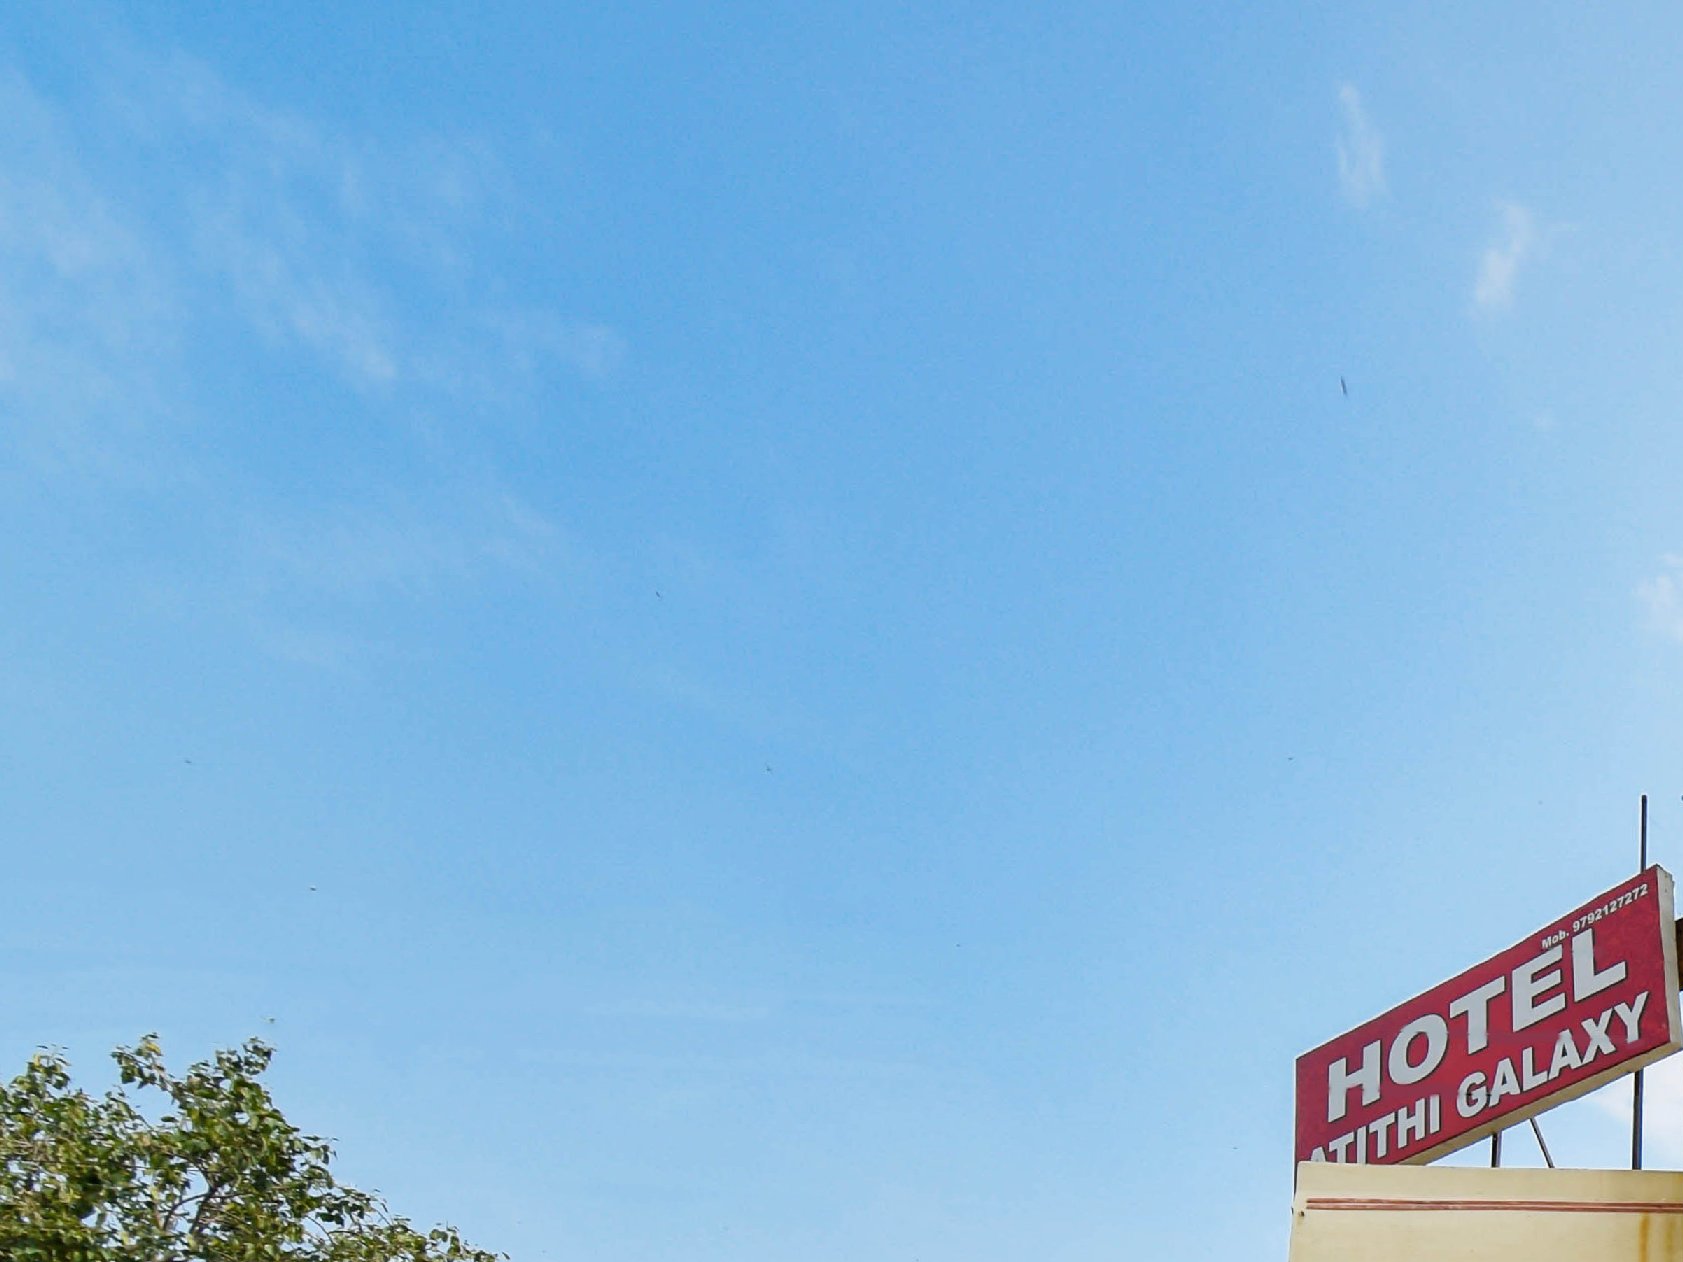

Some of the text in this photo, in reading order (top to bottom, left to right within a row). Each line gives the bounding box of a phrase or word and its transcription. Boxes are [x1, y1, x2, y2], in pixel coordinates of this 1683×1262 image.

[1541, 884, 1649, 950] Mob. 9792127272
[1328, 928, 1627, 1123] HOTEL
[1456, 991, 1649, 1118] GALAXY
